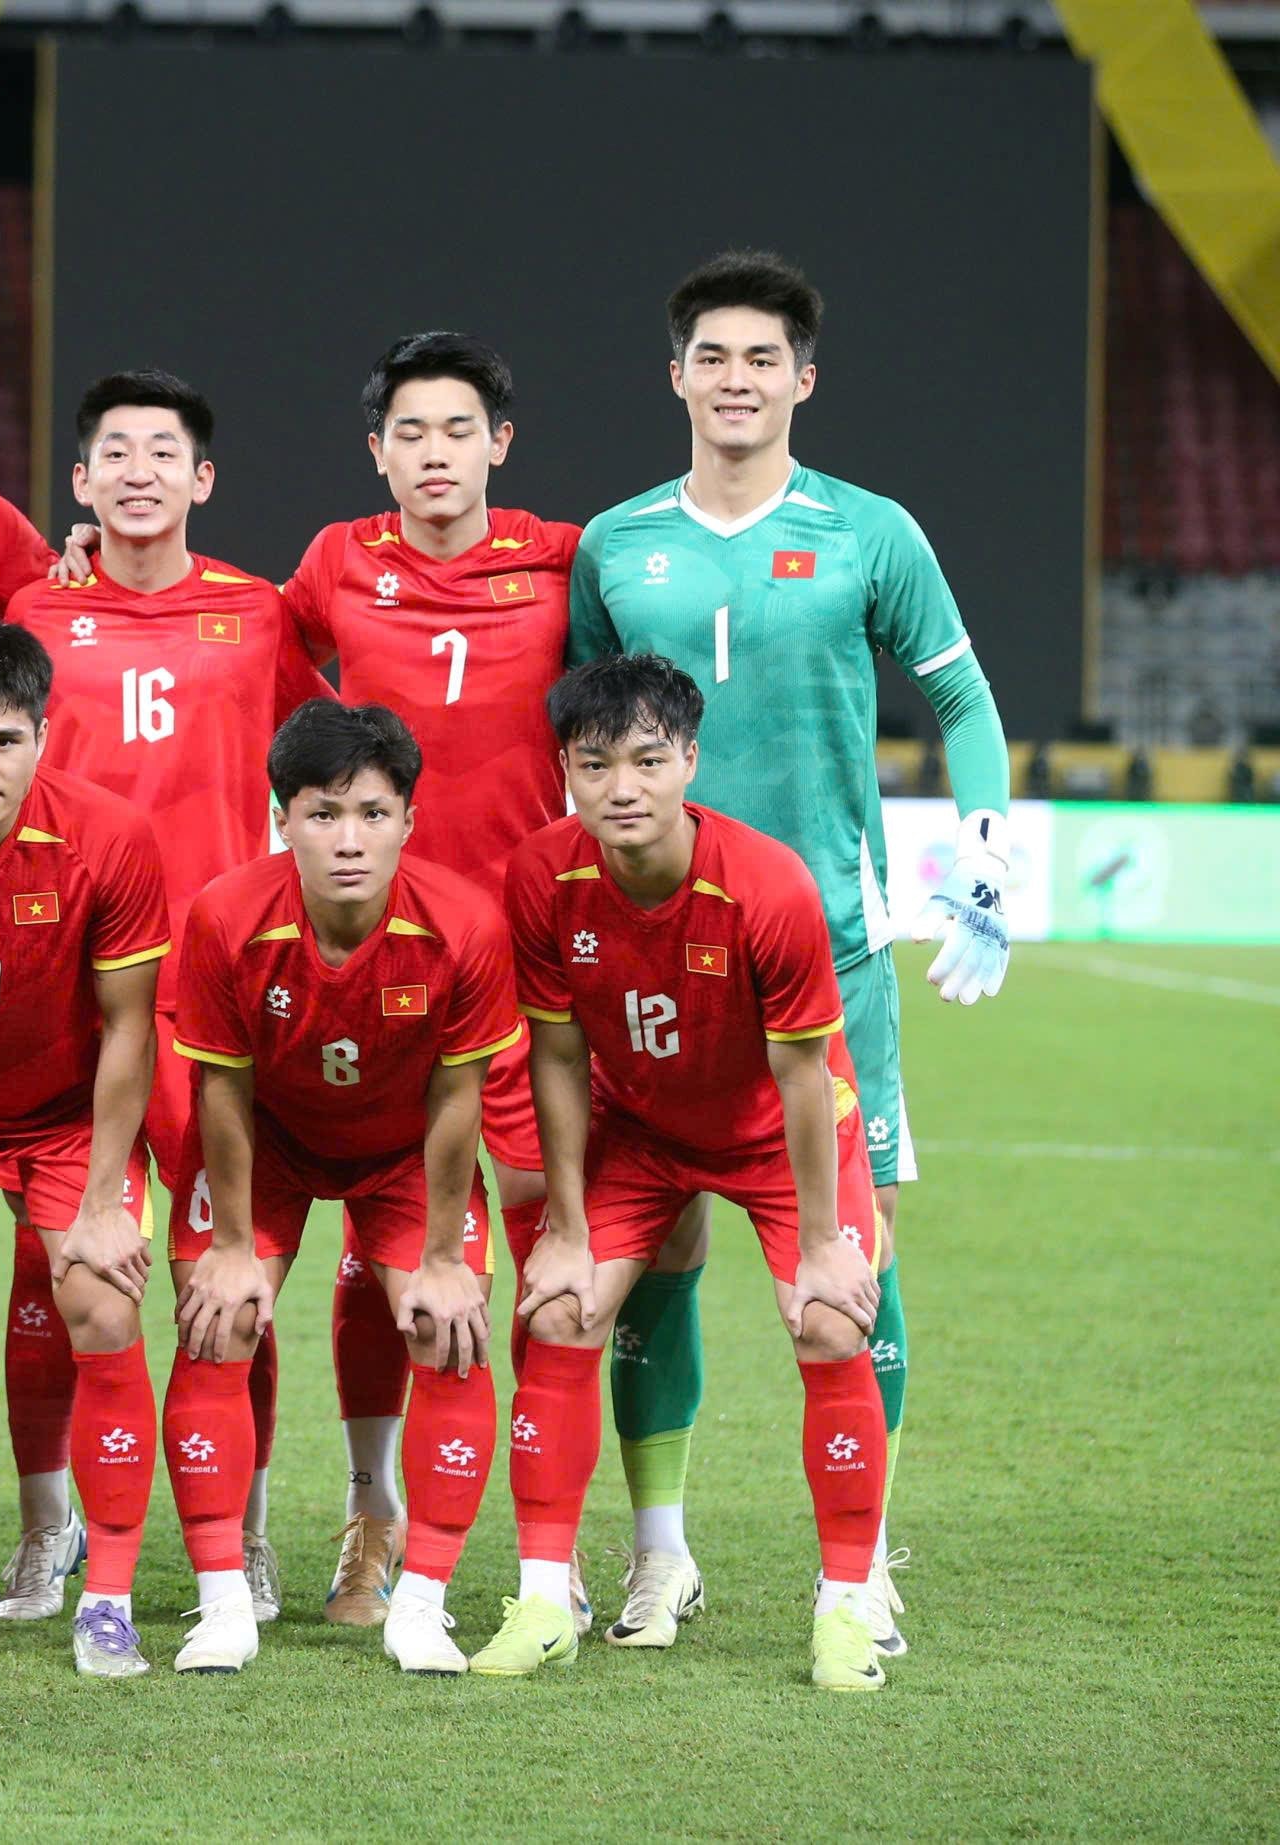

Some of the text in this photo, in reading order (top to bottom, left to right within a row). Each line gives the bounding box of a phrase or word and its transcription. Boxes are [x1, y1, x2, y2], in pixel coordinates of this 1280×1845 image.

[431, 629, 468, 705] 7
[715, 606, 729, 683] 1
[122, 666, 176, 744] 16
[322, 1037, 360, 1087] 8
[624, 989, 680, 1059] 12
